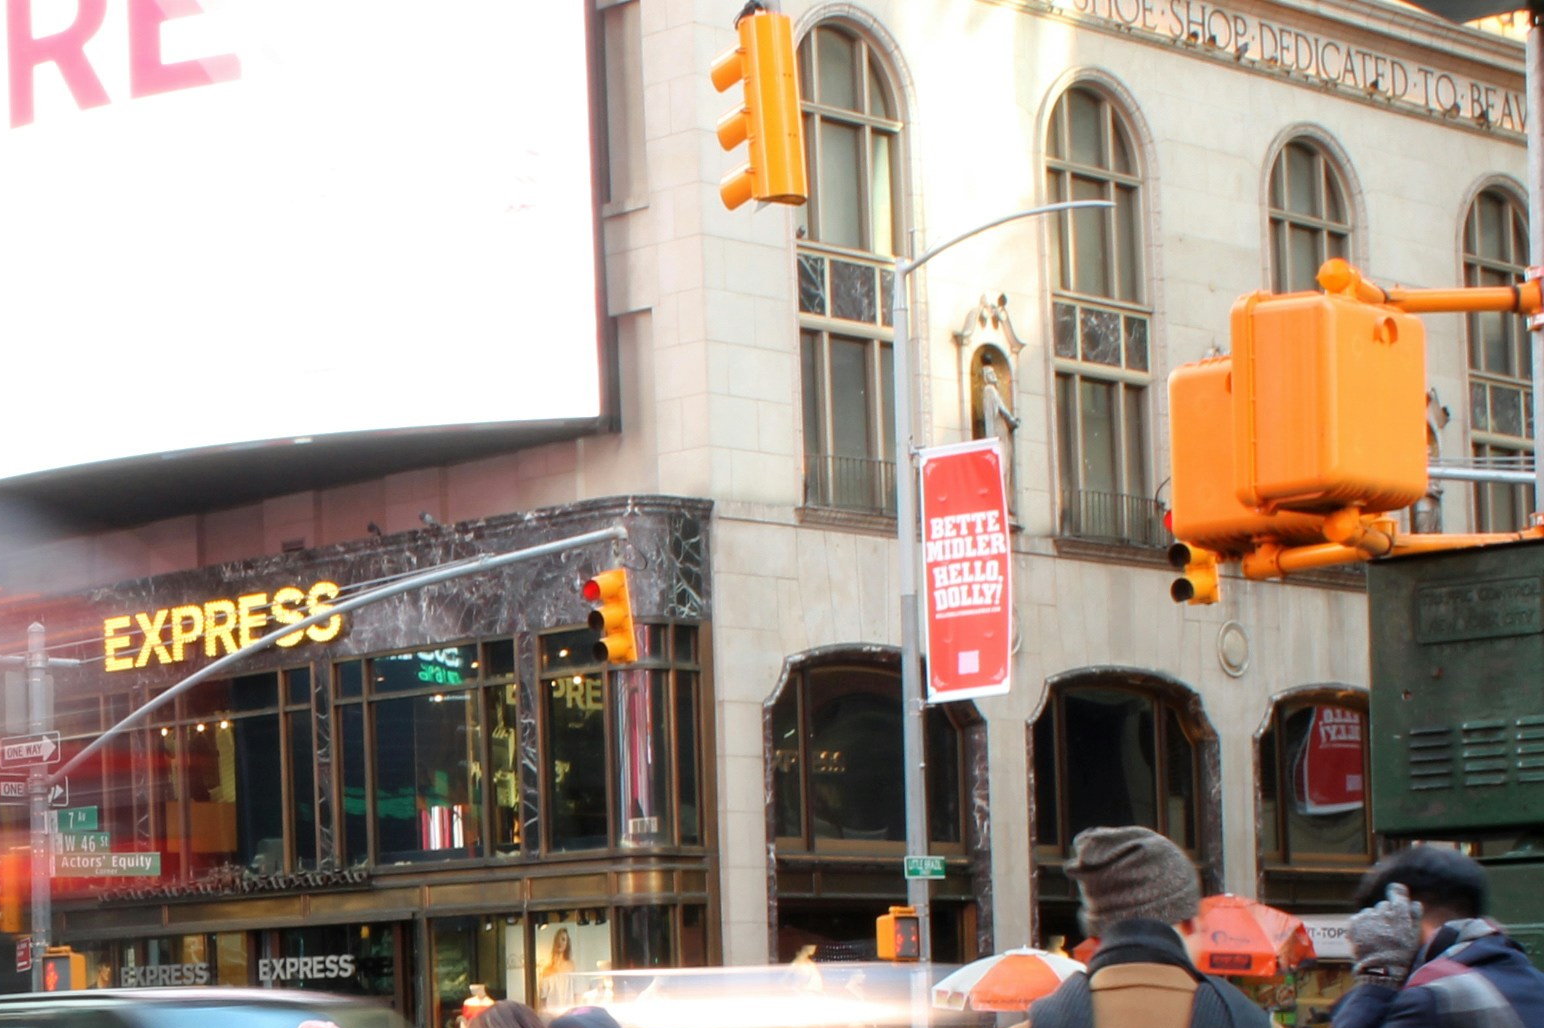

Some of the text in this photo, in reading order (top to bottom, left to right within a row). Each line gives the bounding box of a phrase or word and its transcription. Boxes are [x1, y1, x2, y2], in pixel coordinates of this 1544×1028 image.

[1170, 0, 1248, 50] SHOP
[1259, 22, 1408, 100] DEDICATED
[1417, 68, 1456, 115] TO
[930, 509, 1000, 540] BETTE
[926, 532, 1007, 564] MIDLER
[932, 560, 1004, 589] HELLO,
[933, 582, 1003, 613] DOLLY!
[103, 581, 343, 673] EXPRESS
[6, 743, 43, 759] ONE WAY
[3, 782, 24, 796] ONE
[68, 812, 74, 829] 7
[65, 836, 76, 851] W
[81, 835, 96, 852] 46
[61, 856, 152, 870] Actors' Equity
[121, 963, 211, 988] EXPRESS
[259, 955, 356, 981] EXPRESS
